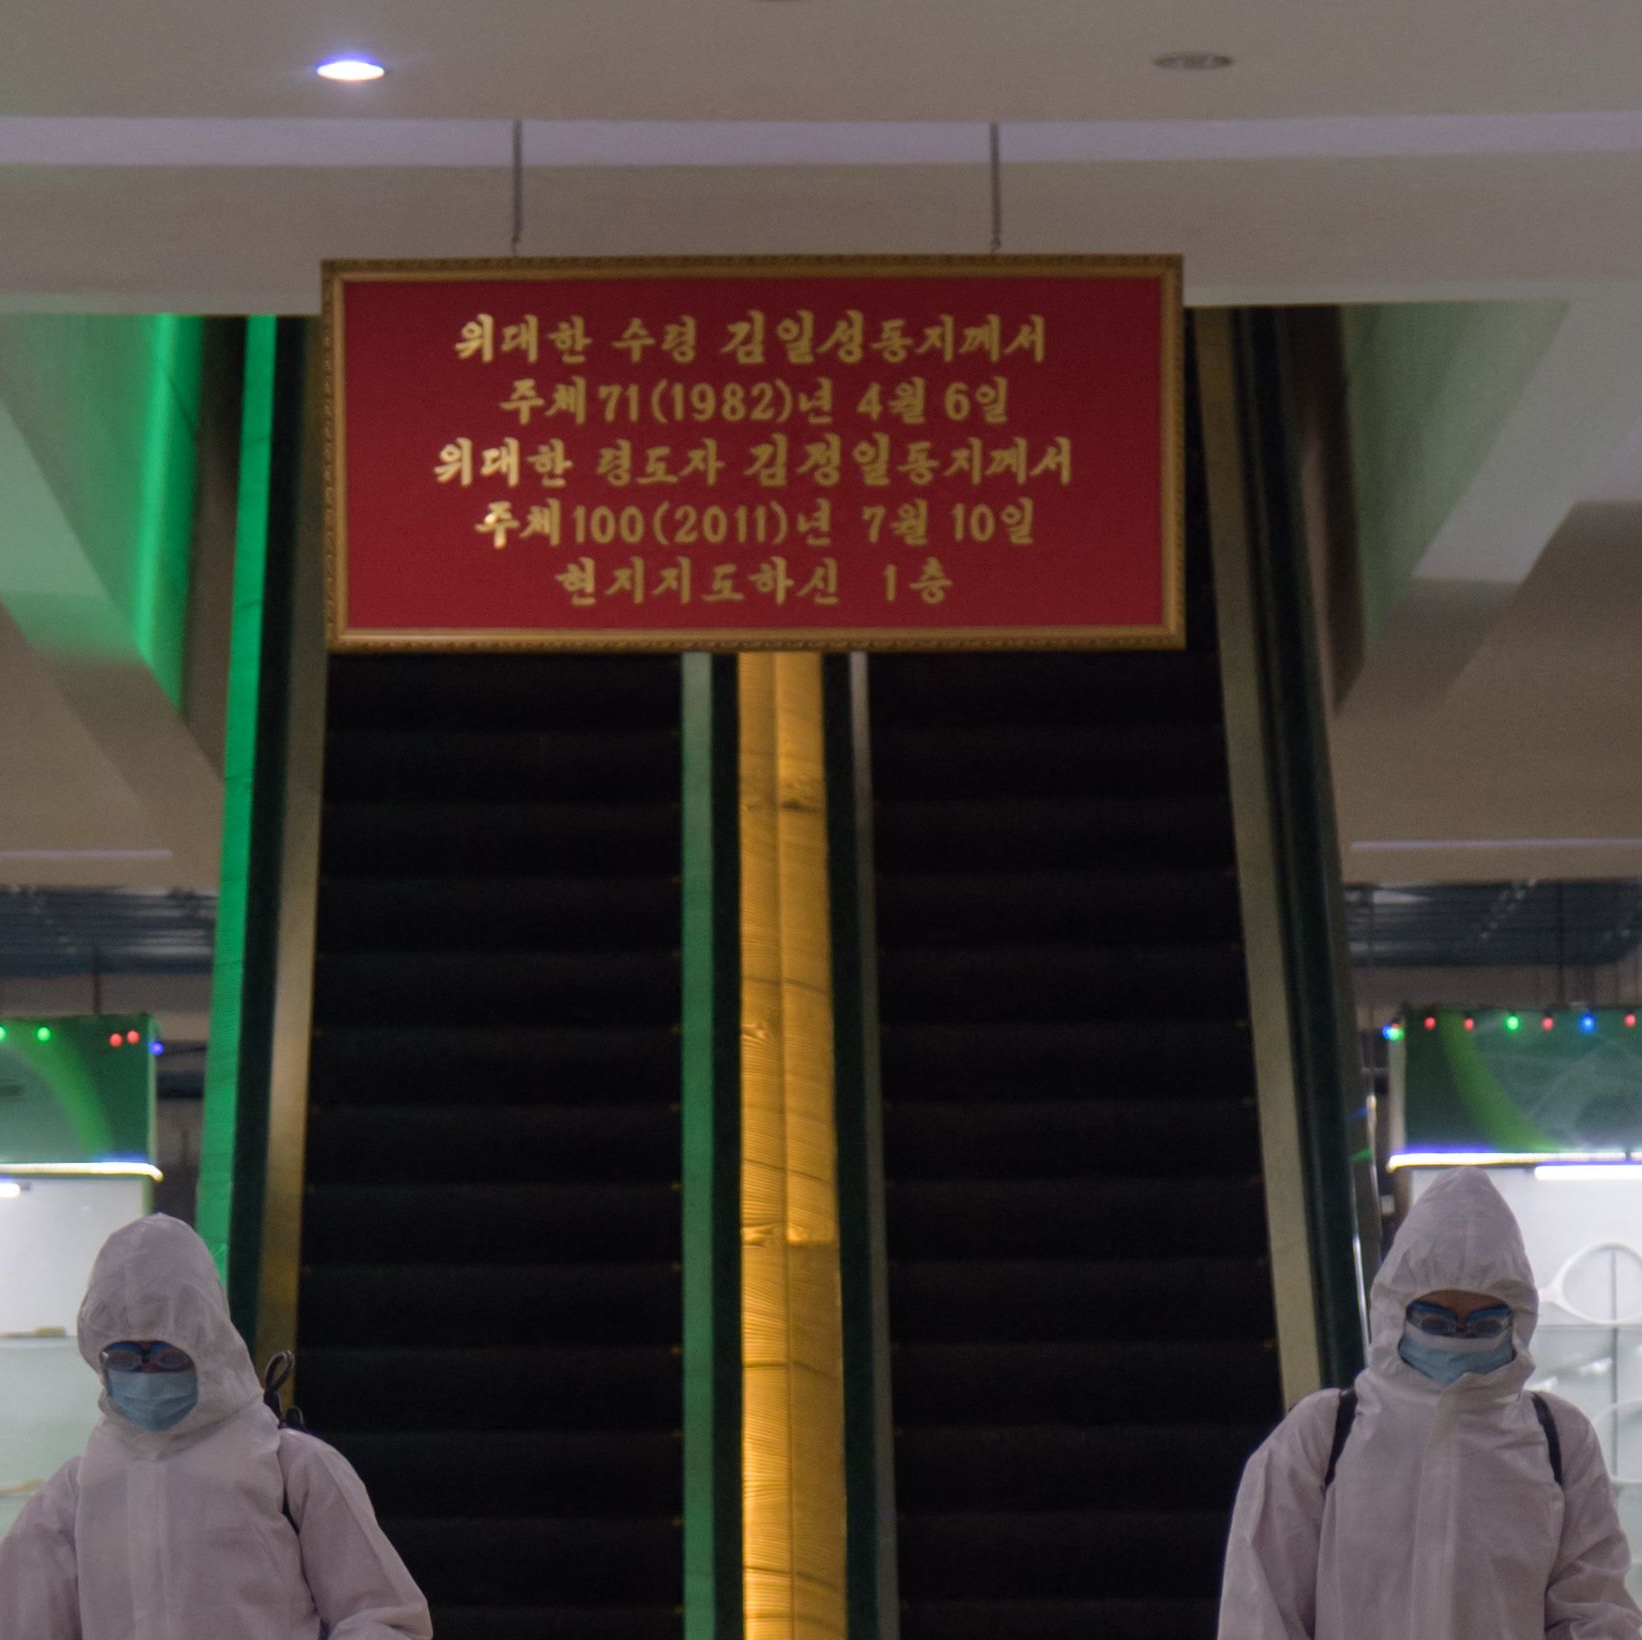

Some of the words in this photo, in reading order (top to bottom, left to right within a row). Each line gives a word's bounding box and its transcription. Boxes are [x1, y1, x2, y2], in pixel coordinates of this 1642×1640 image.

[452, 311, 592, 365] 위대한
[612, 314, 696, 364] 수령
[720, 308, 1045, 365] 김일성동지께서
[856, 375, 925, 425] 4월
[943, 375, 1008, 424] 6일
[431, 434, 574, 489] 위대한
[595, 436, 725, 488] 령도자
[743, 431, 1071, 487] 김정일동지께서
[861, 497, 928, 546] 7월
[951, 496, 1034, 545] 10일
[553, 554, 839, 607] 현지지도하신
